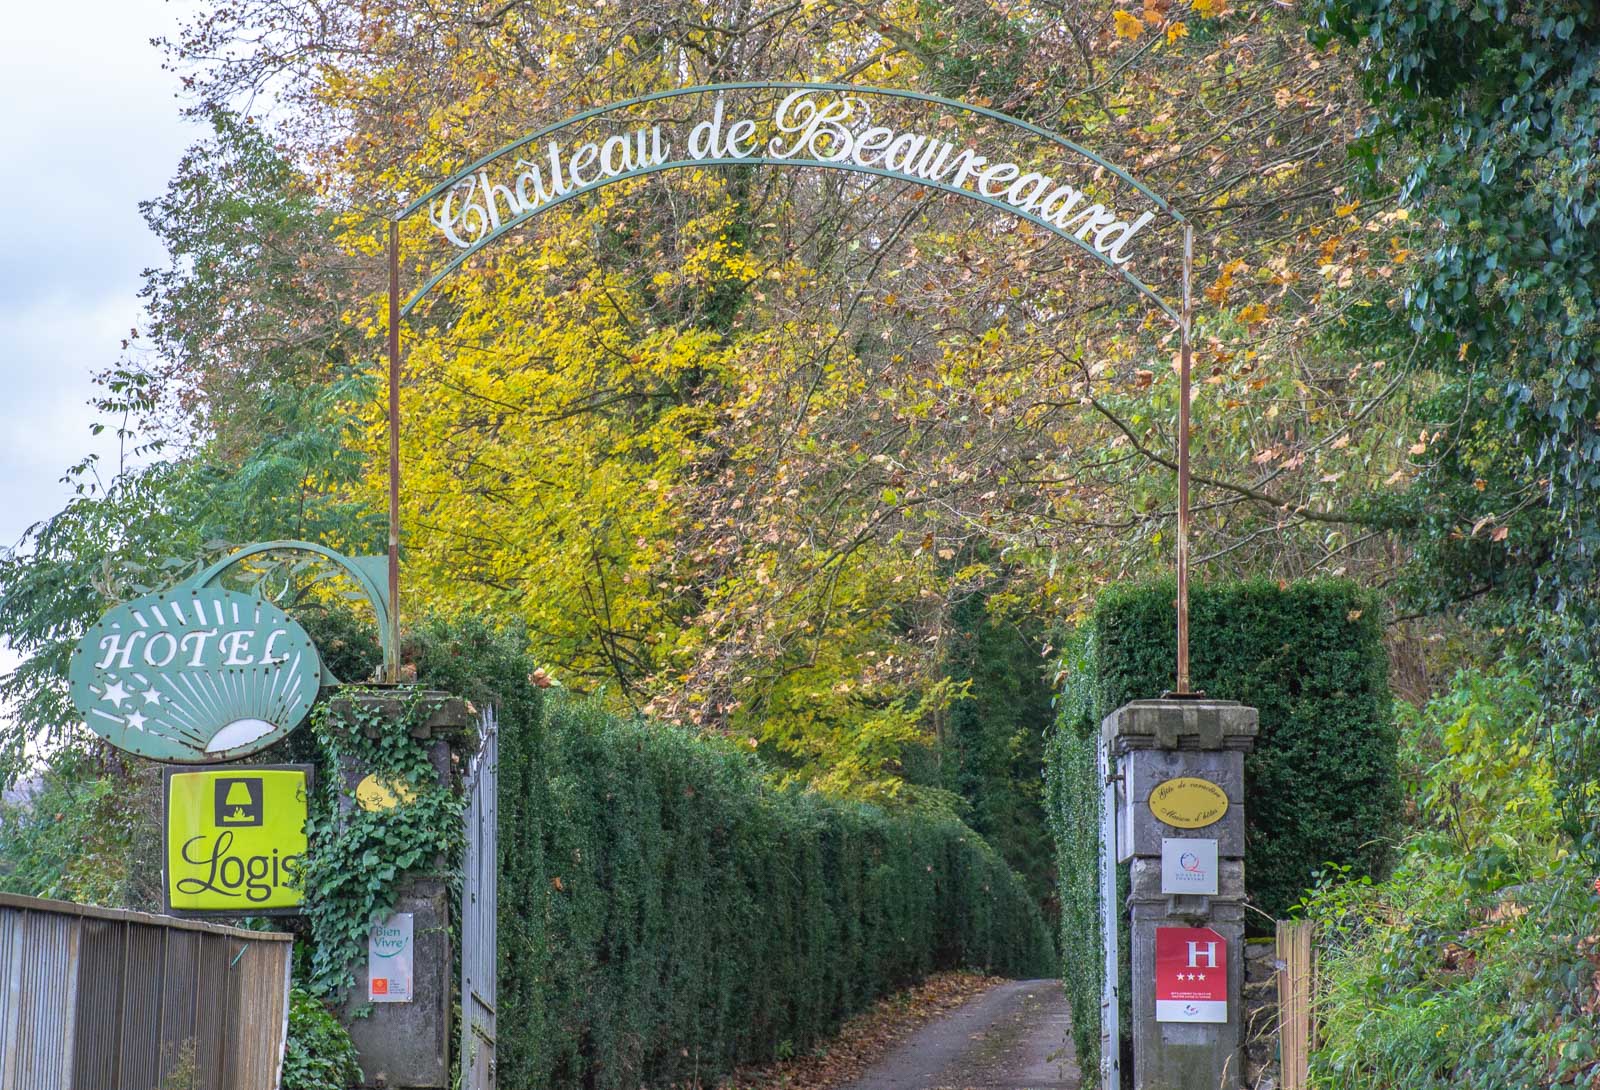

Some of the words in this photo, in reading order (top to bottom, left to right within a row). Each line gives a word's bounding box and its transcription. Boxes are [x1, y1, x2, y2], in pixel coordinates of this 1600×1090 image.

[429, 126, 670, 248] Château
[688, 96, 758, 159] de
[95, 628, 290, 670] HOTEL
[376, 926, 401, 937] Bien
[1186, 941, 1221, 968] H
